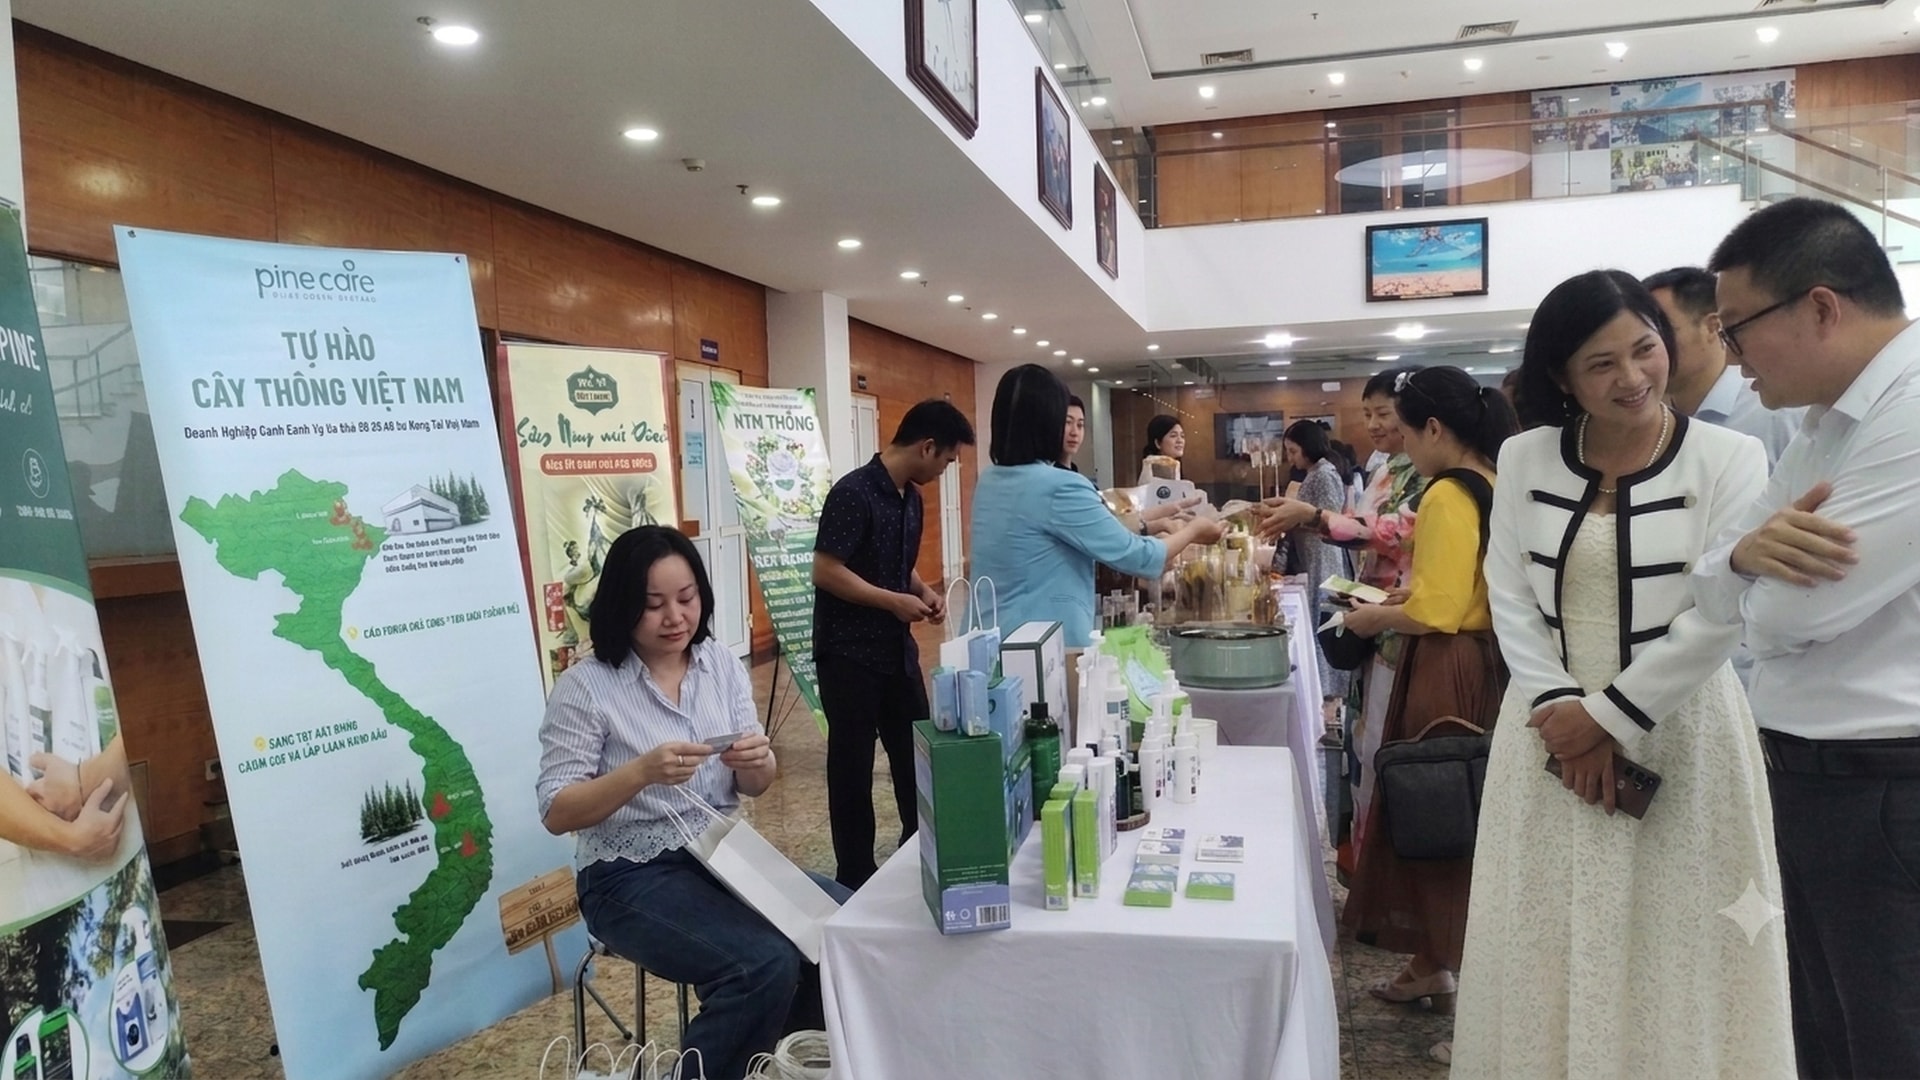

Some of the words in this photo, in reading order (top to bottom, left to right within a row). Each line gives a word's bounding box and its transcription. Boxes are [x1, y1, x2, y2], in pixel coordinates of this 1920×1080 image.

[255, 264, 315, 299] pine
[319, 259, 375, 293] care
[0, 326, 41, 371] PINE
[281, 329, 317, 369] TỰ
[324, 326, 376, 361] HÀO
[191, 370, 245, 409] CÂY
[255, 370, 346, 407] THÔNG
[352, 370, 406, 412] VIỆT
[414, 376, 465, 404] NAM
[734, 413, 763, 430] NTM
